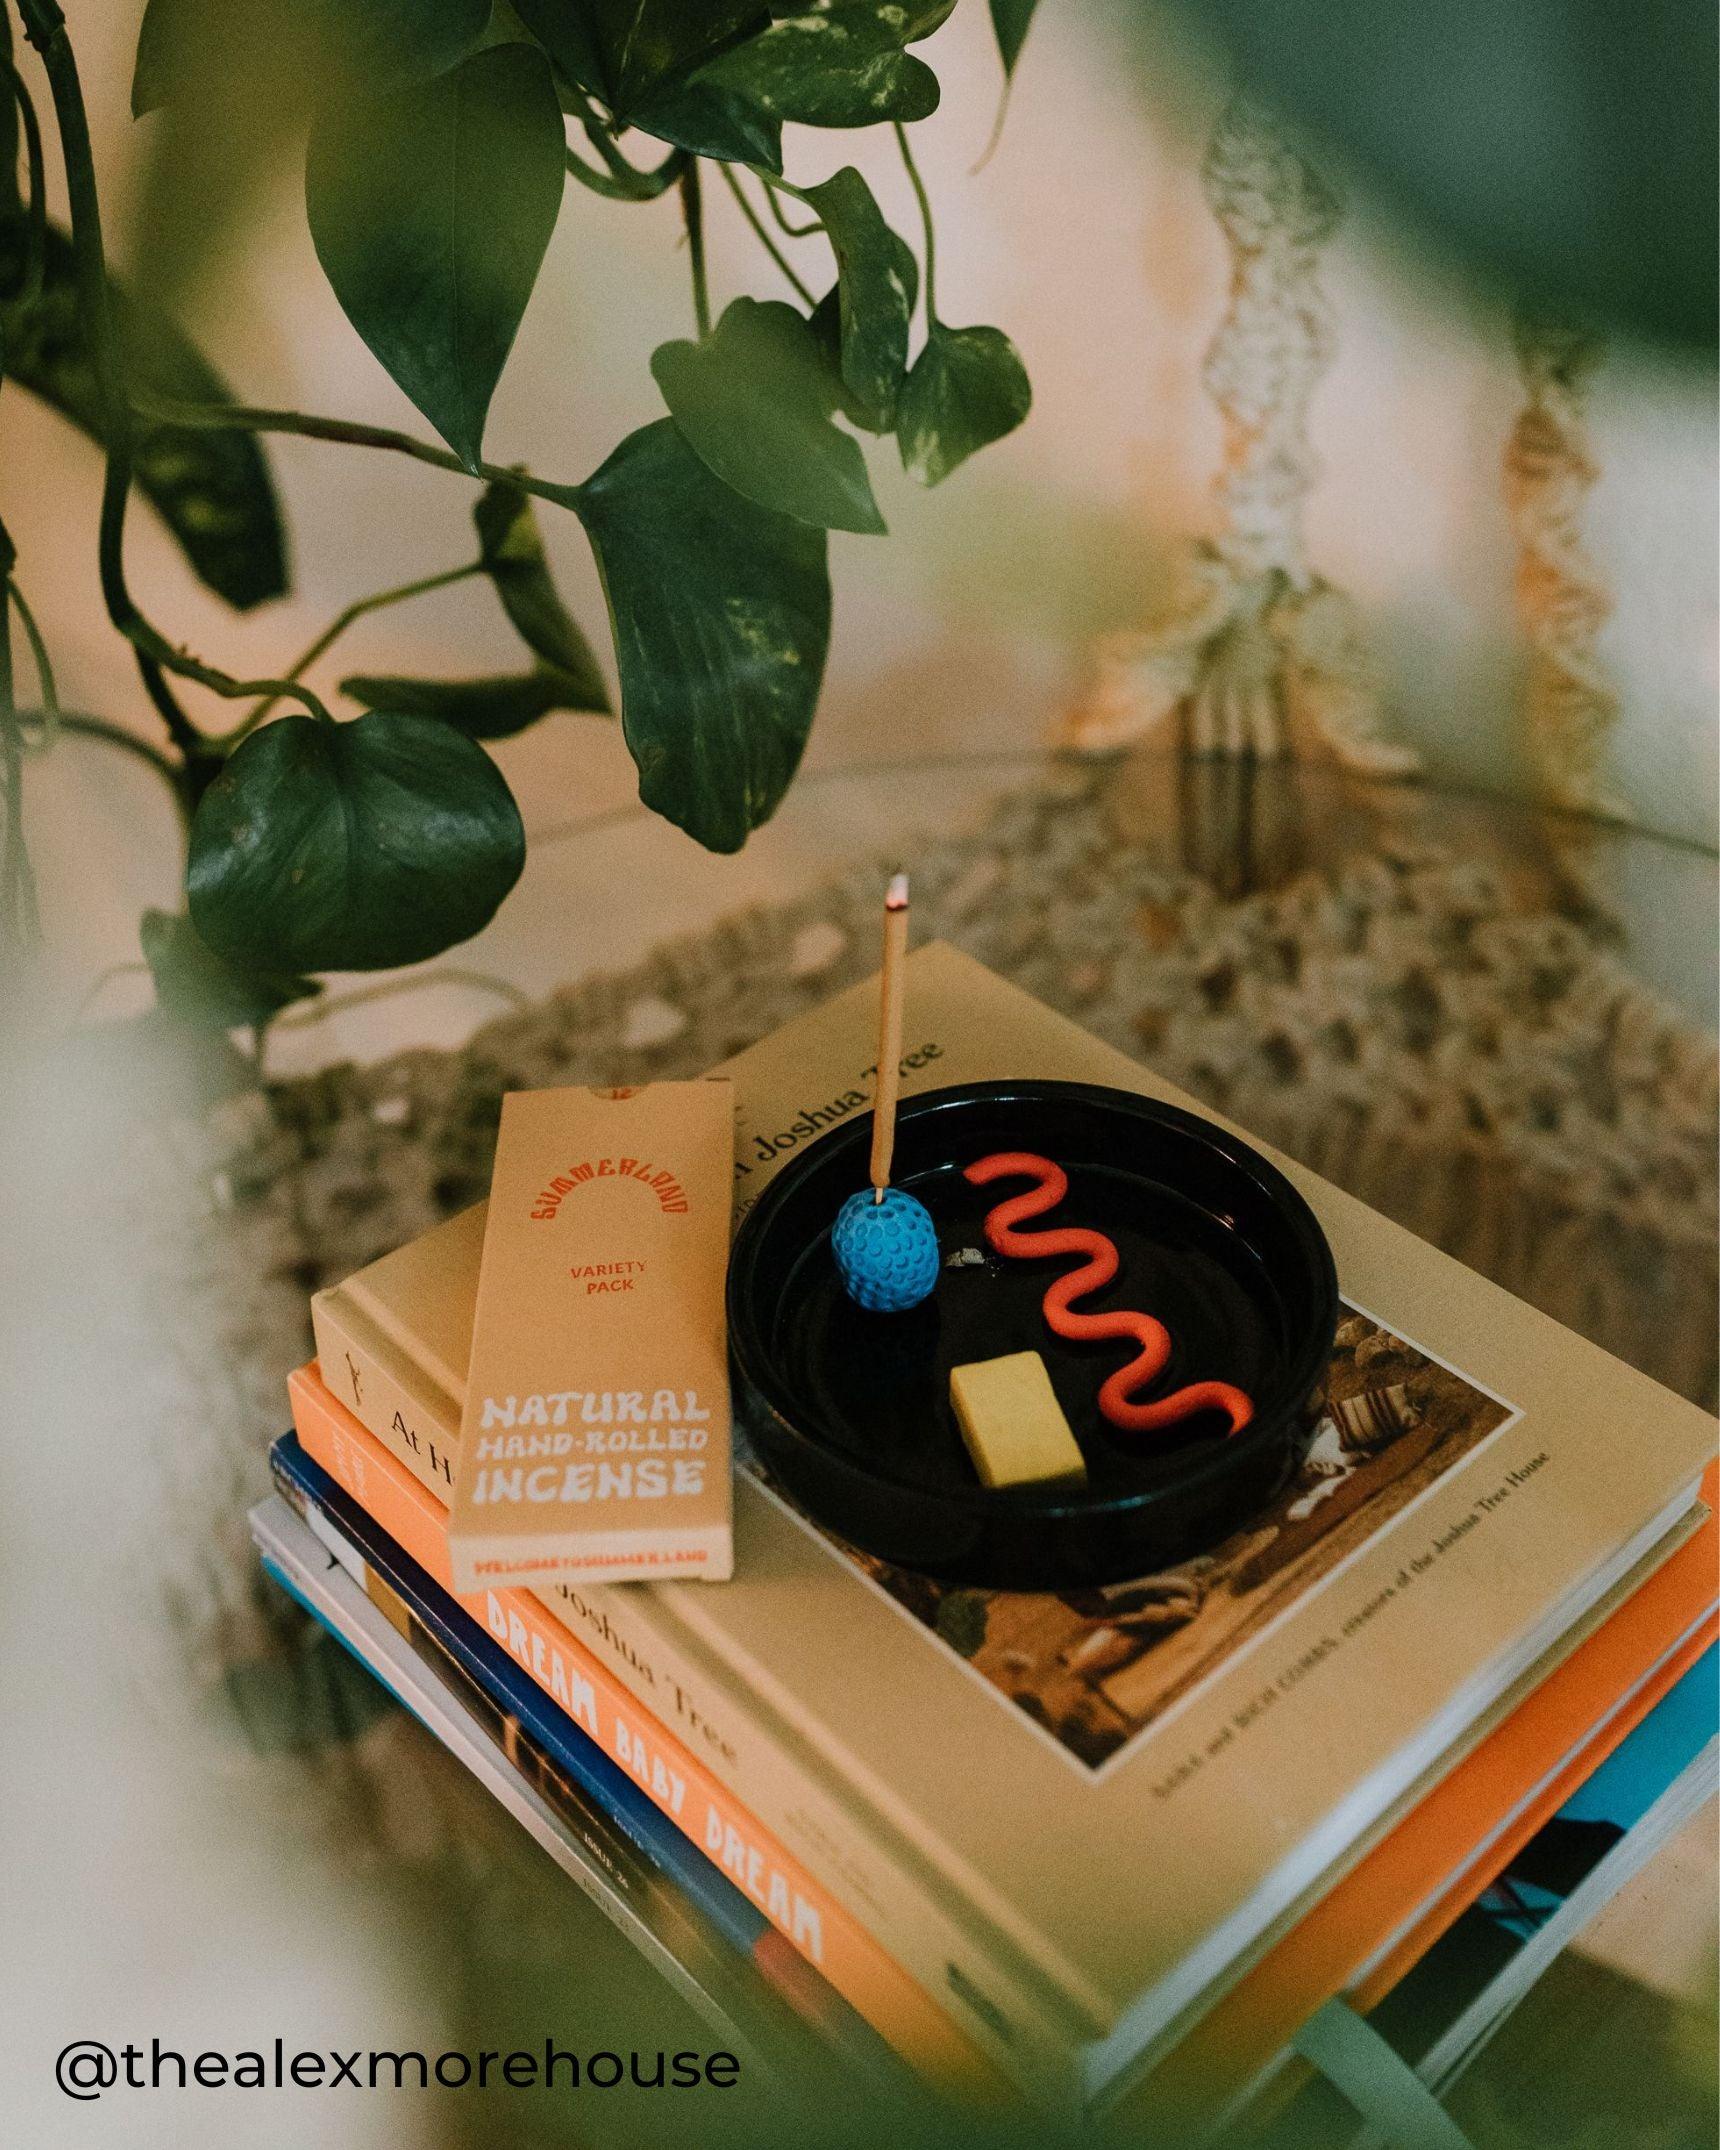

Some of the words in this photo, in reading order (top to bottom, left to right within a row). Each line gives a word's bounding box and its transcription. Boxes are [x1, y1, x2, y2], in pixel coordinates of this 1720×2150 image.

[753, 1088, 870, 1162] Joshua
[530, 1158, 689, 1220] SUMMERLAND
[570, 1260, 648, 1279] VARIETY
[586, 1278, 634, 1294] PACK
[480, 1388, 711, 1429] NATURAL
[391, 1410, 421, 1455] At
[475, 1428, 709, 1461] HAND-ROLLED
[472, 1458, 706, 1505] INCENSE
[1473, 1486, 1510, 1514] Tree
[1504, 1450, 1550, 1488] House
[487, 1589, 599, 1737] DREAM
[615, 1716, 686, 1817] BABY
[706, 1803, 824, 1965] DREAM
